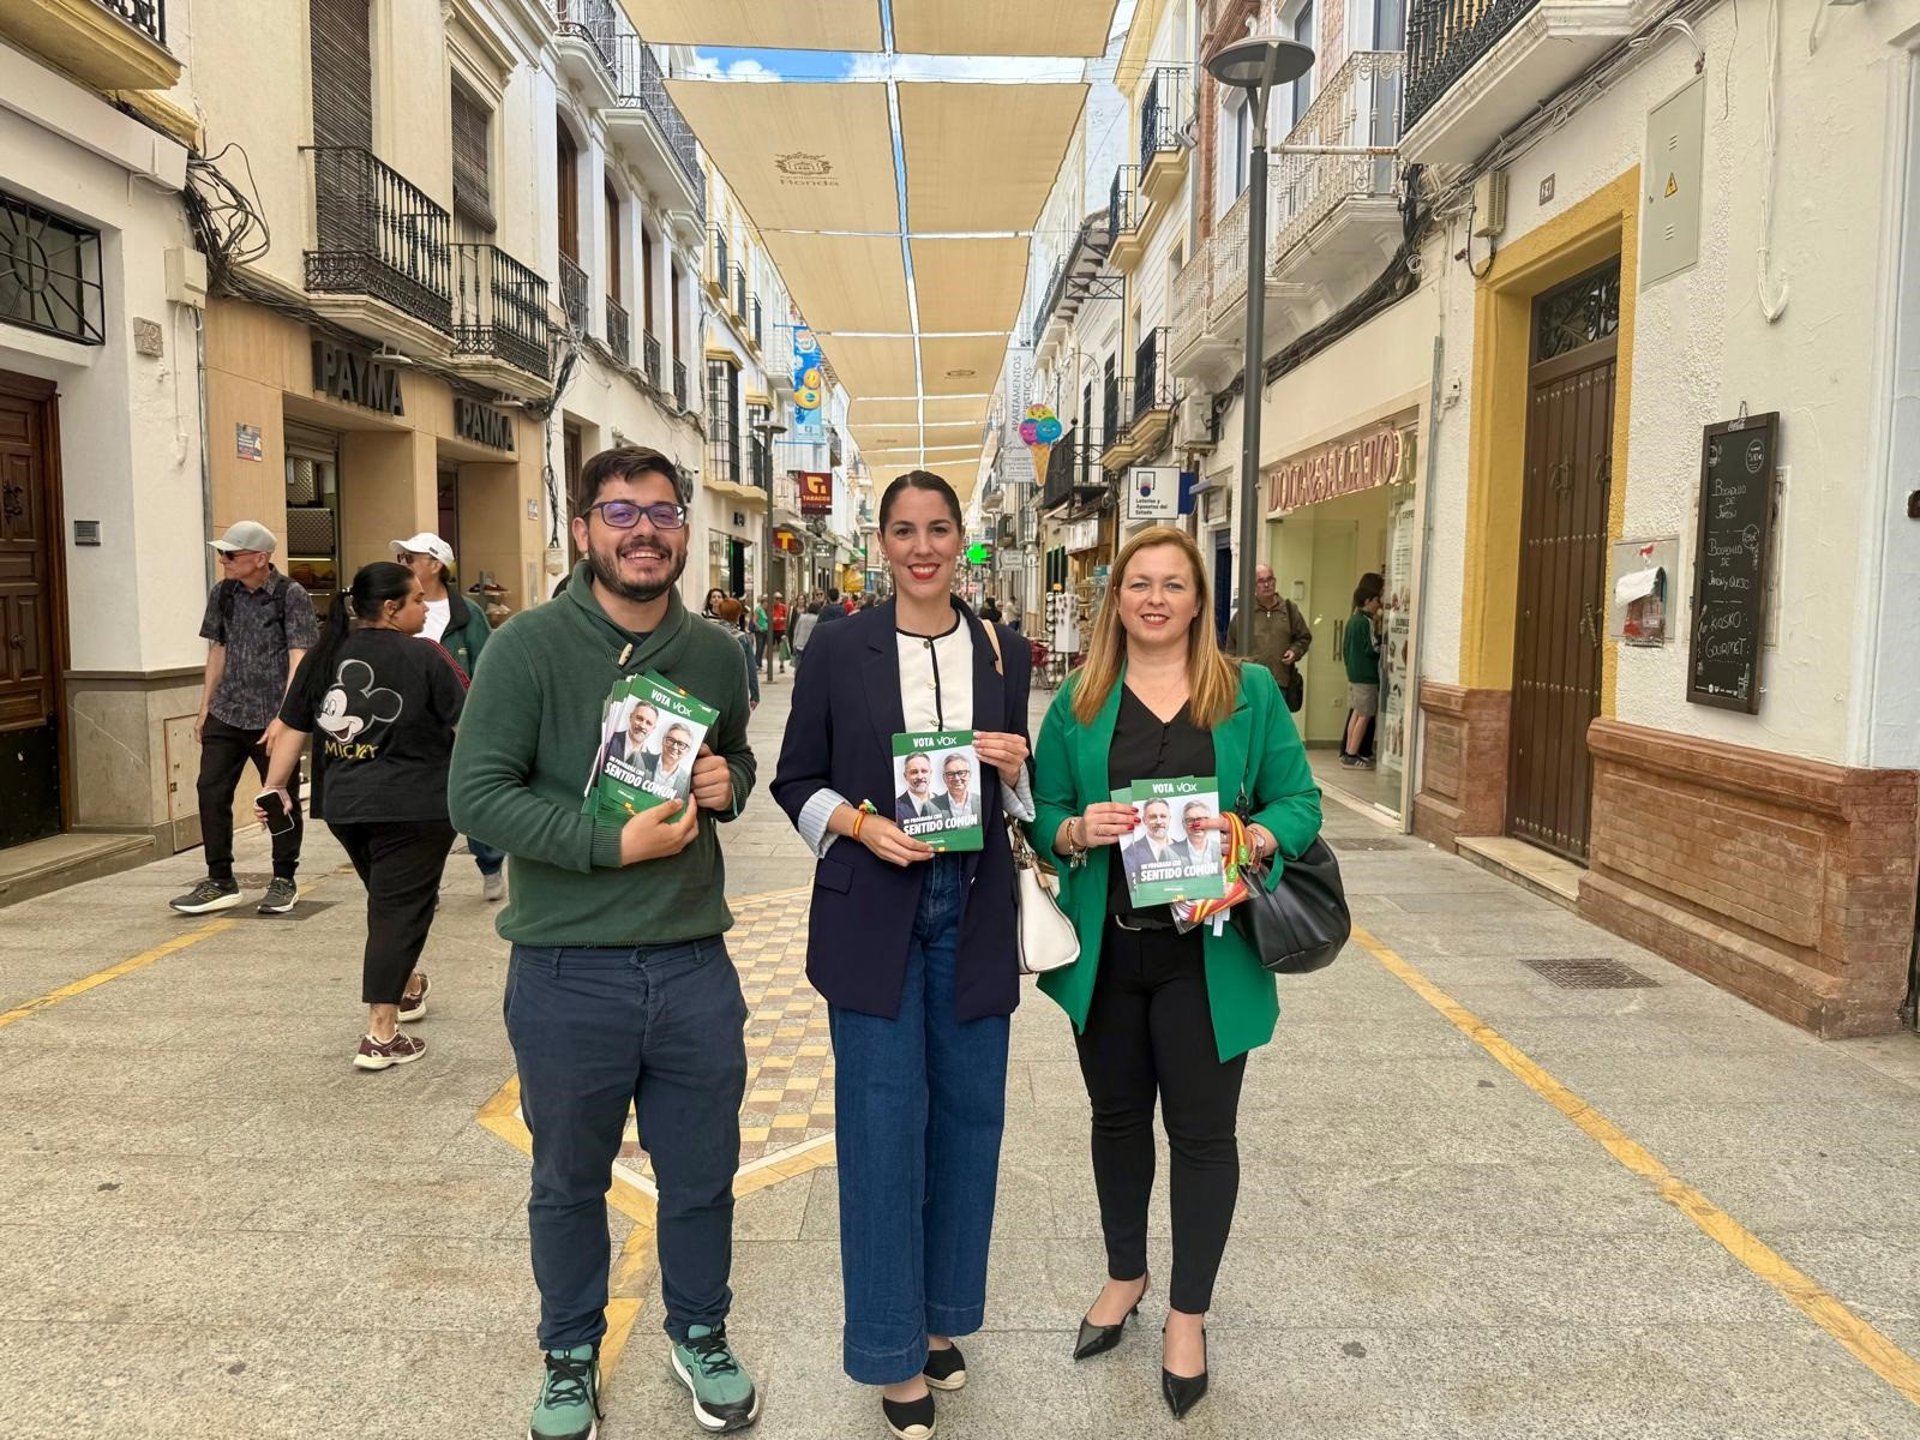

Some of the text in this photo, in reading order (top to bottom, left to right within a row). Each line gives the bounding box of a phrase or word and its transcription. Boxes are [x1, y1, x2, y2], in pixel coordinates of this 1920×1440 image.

[314, 342, 405, 416] PAYMA
[1012, 355, 1021, 432] APARTAMENTOS
[456, 400, 515, 451] PAYMA
[651, 689, 671, 707] VOTA
[673, 702, 692, 717] VOX
[913, 736, 957, 748] VOTA VOX
[604, 761, 642, 787] SENTIDO
[1152, 781, 1197, 793] VOTA VOX
[903, 820, 943, 836] SENTIDO
[1141, 866, 1182, 881] SENTIDO
